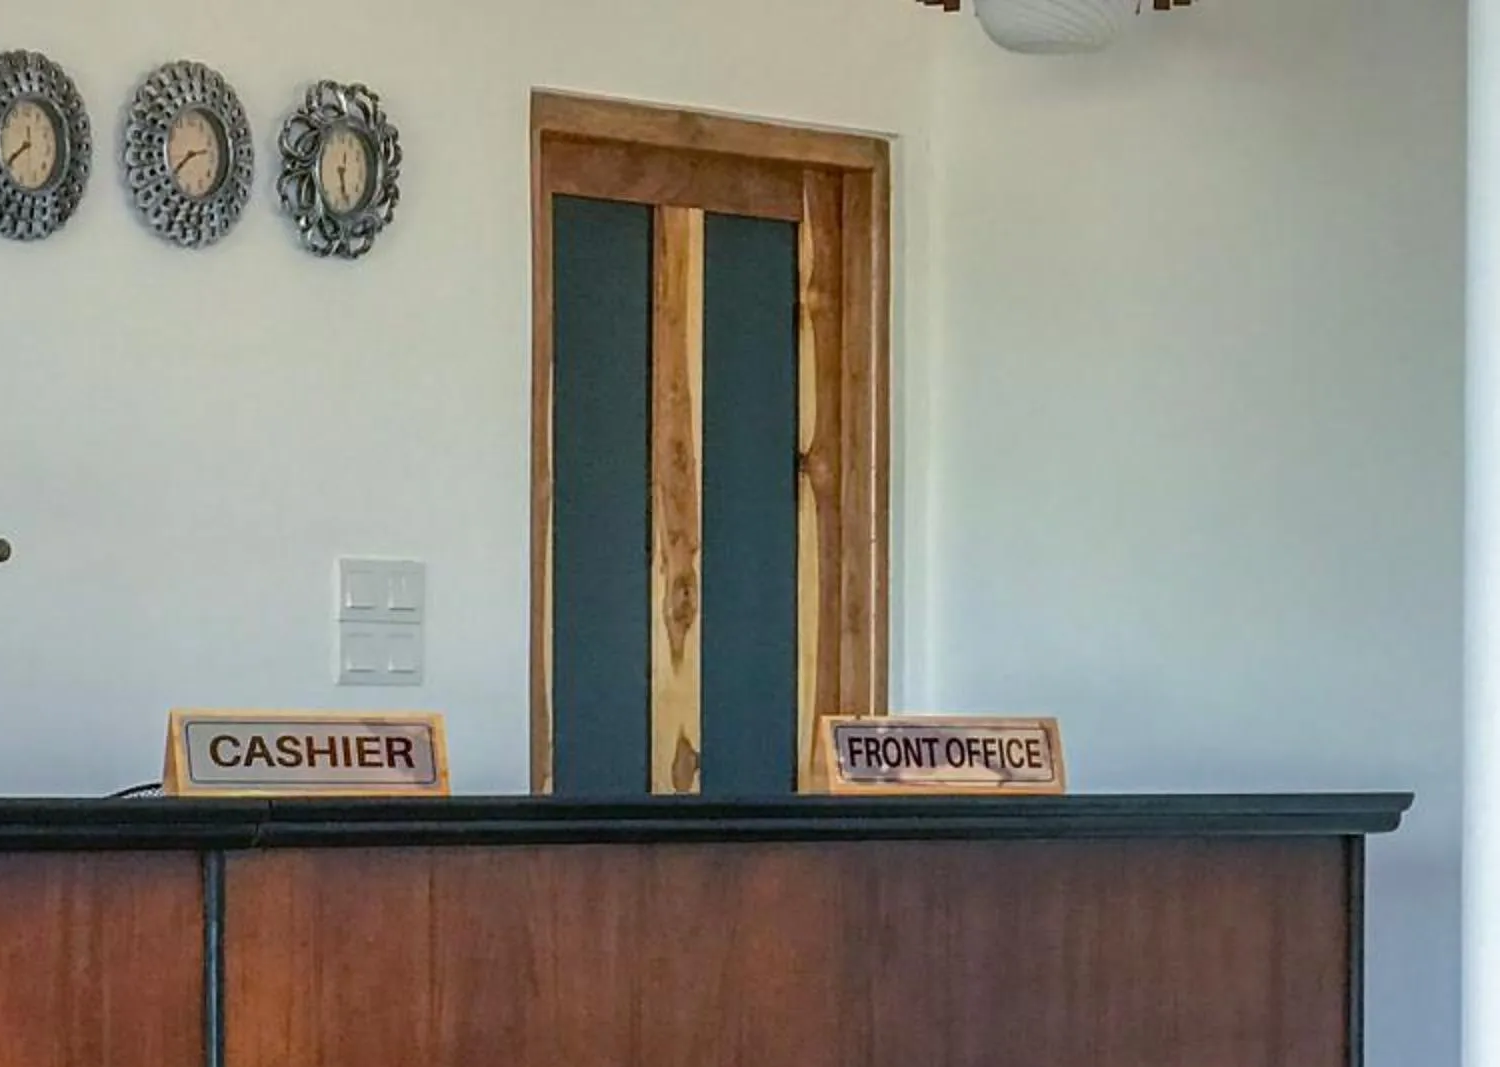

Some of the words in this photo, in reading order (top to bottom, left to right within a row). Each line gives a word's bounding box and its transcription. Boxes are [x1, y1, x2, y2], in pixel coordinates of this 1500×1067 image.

[208, 734, 415, 769] CASHIER
[847, 735, 940, 768] FRONT
[945, 737, 1044, 769] OFFICE
